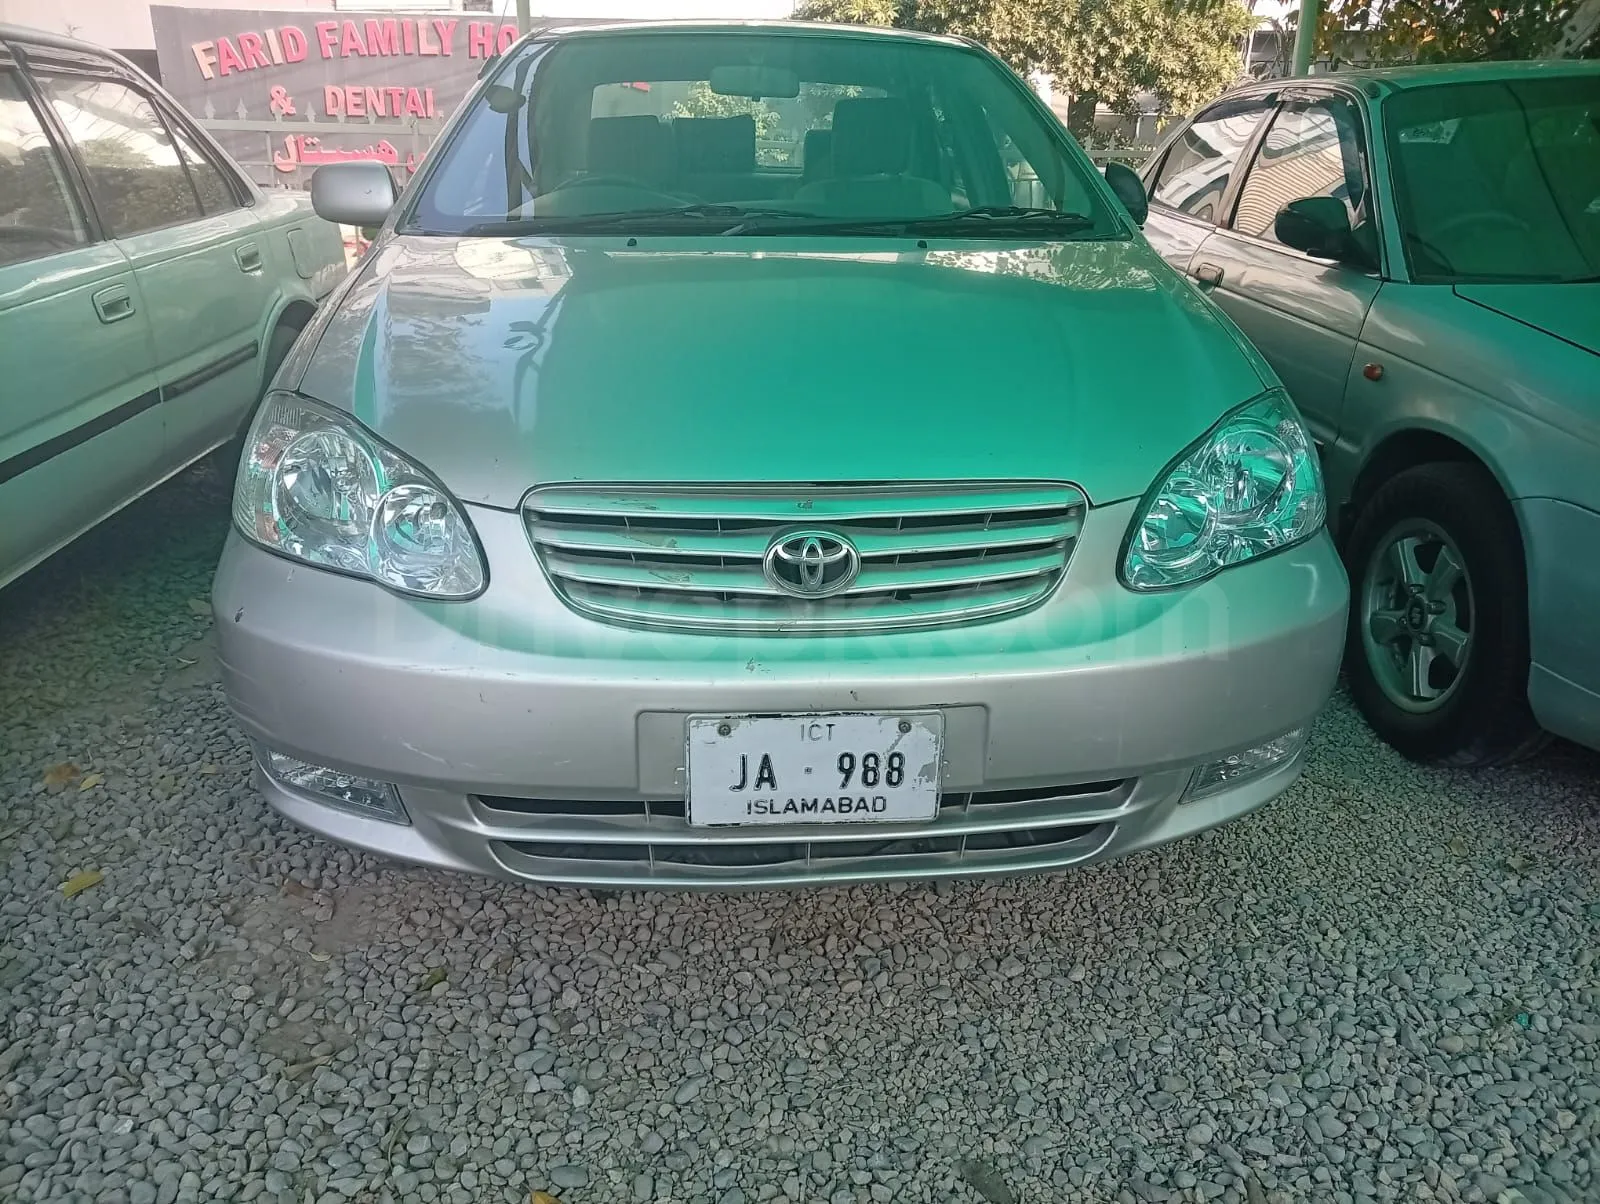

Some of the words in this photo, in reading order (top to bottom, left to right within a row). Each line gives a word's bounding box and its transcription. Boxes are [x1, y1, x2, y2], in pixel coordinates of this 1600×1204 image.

[192, 26, 308, 80] FARID
[316, 18, 458, 59] FAMILY
[270, 84, 296, 117] &
[800, 723, 836, 742] ICT
[729, 752, 778, 792] JA
[836, 751, 906, 790] 988
[746, 795, 887, 815] ISLAMABAD
